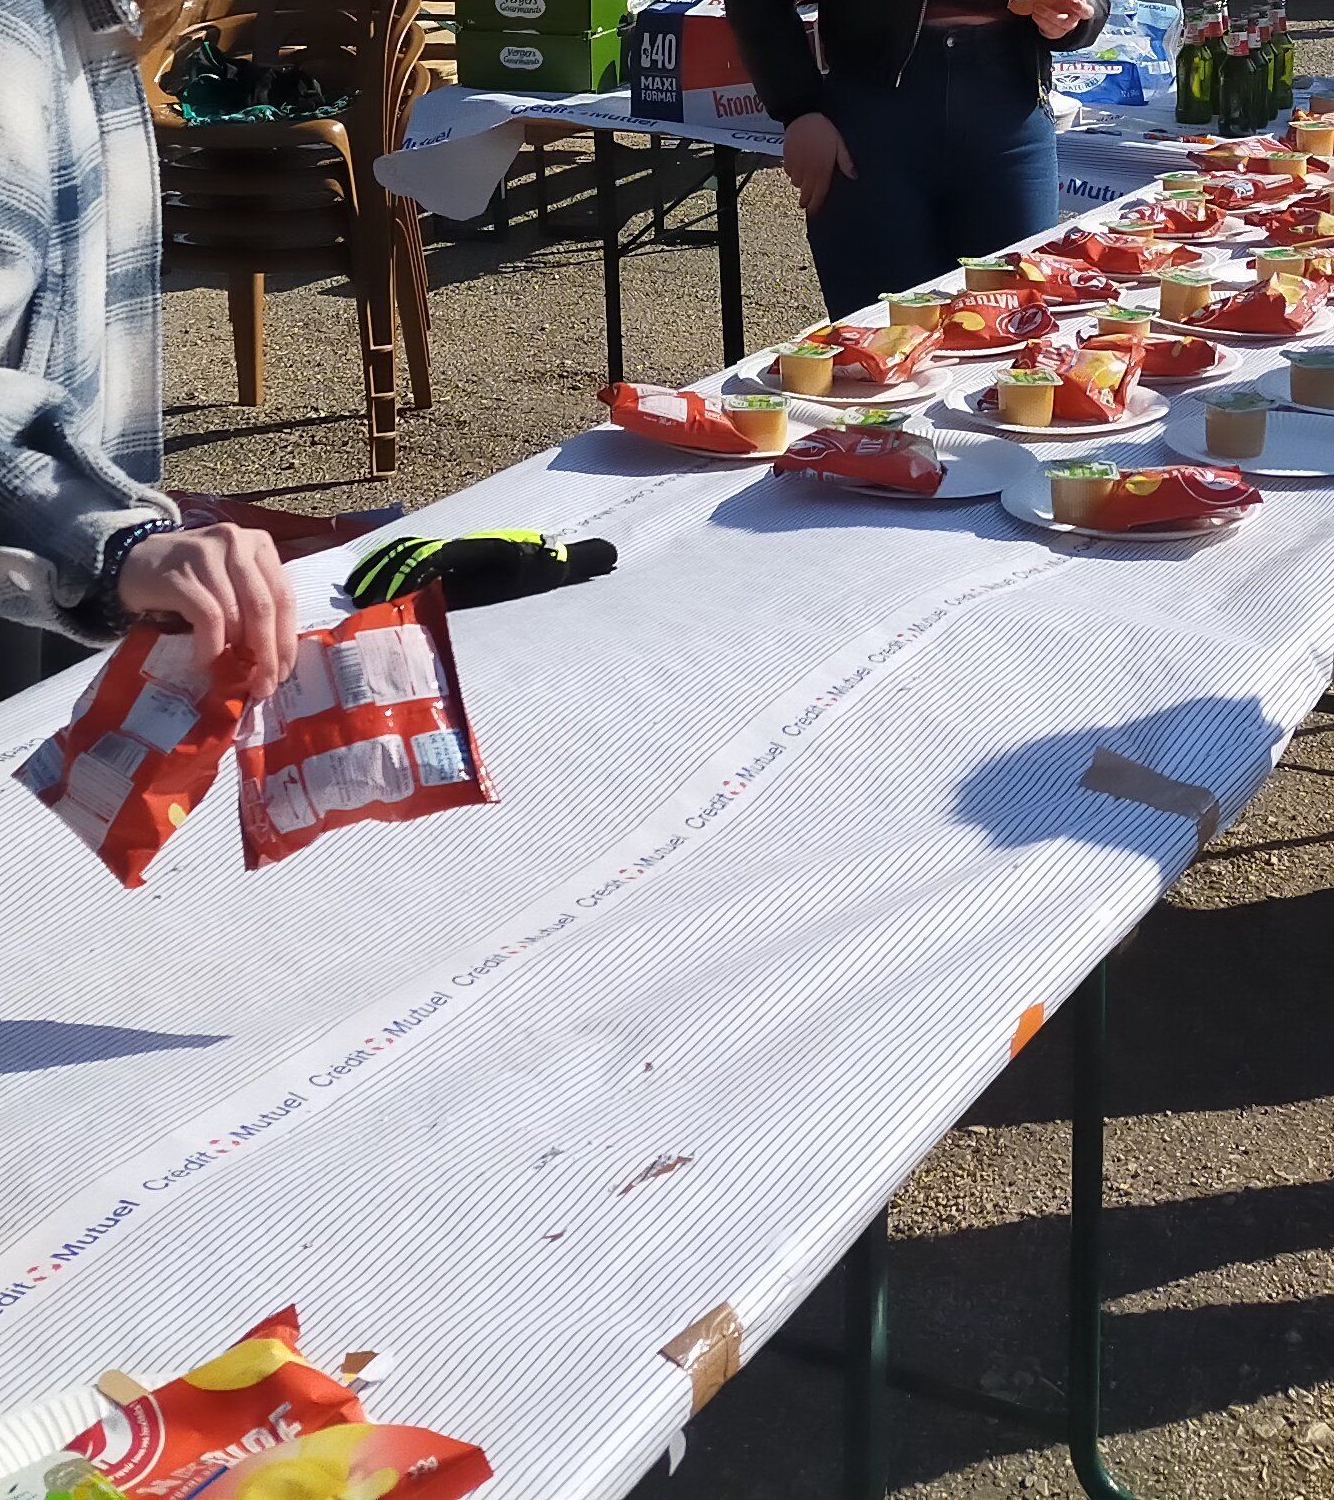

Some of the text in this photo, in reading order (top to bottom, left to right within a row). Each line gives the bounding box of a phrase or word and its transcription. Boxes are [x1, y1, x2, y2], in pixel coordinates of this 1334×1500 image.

[651, 32, 677, 70] 40
[640, 76, 677, 91] MAXI
[641, 91, 677, 103] FORMAT
[712, 90, 764, 119] Krone
[1066, 178, 1125, 201] Mutu
[51, 1198, 142, 1265] Mutuel
[141, 1151, 216, 1193] Crédit
[231, 1091, 309, 1142] Mutuel
[308, 1048, 373, 1089] Crédit
[385, 990, 453, 1041] Mutuel
[451, 953, 508, 989] Crédit
[638, 833, 689, 871] Mutuel
[684, 791, 736, 831] Crédit
[735, 740, 788, 785] Mutuel
[781, 703, 826, 738] Crédit
